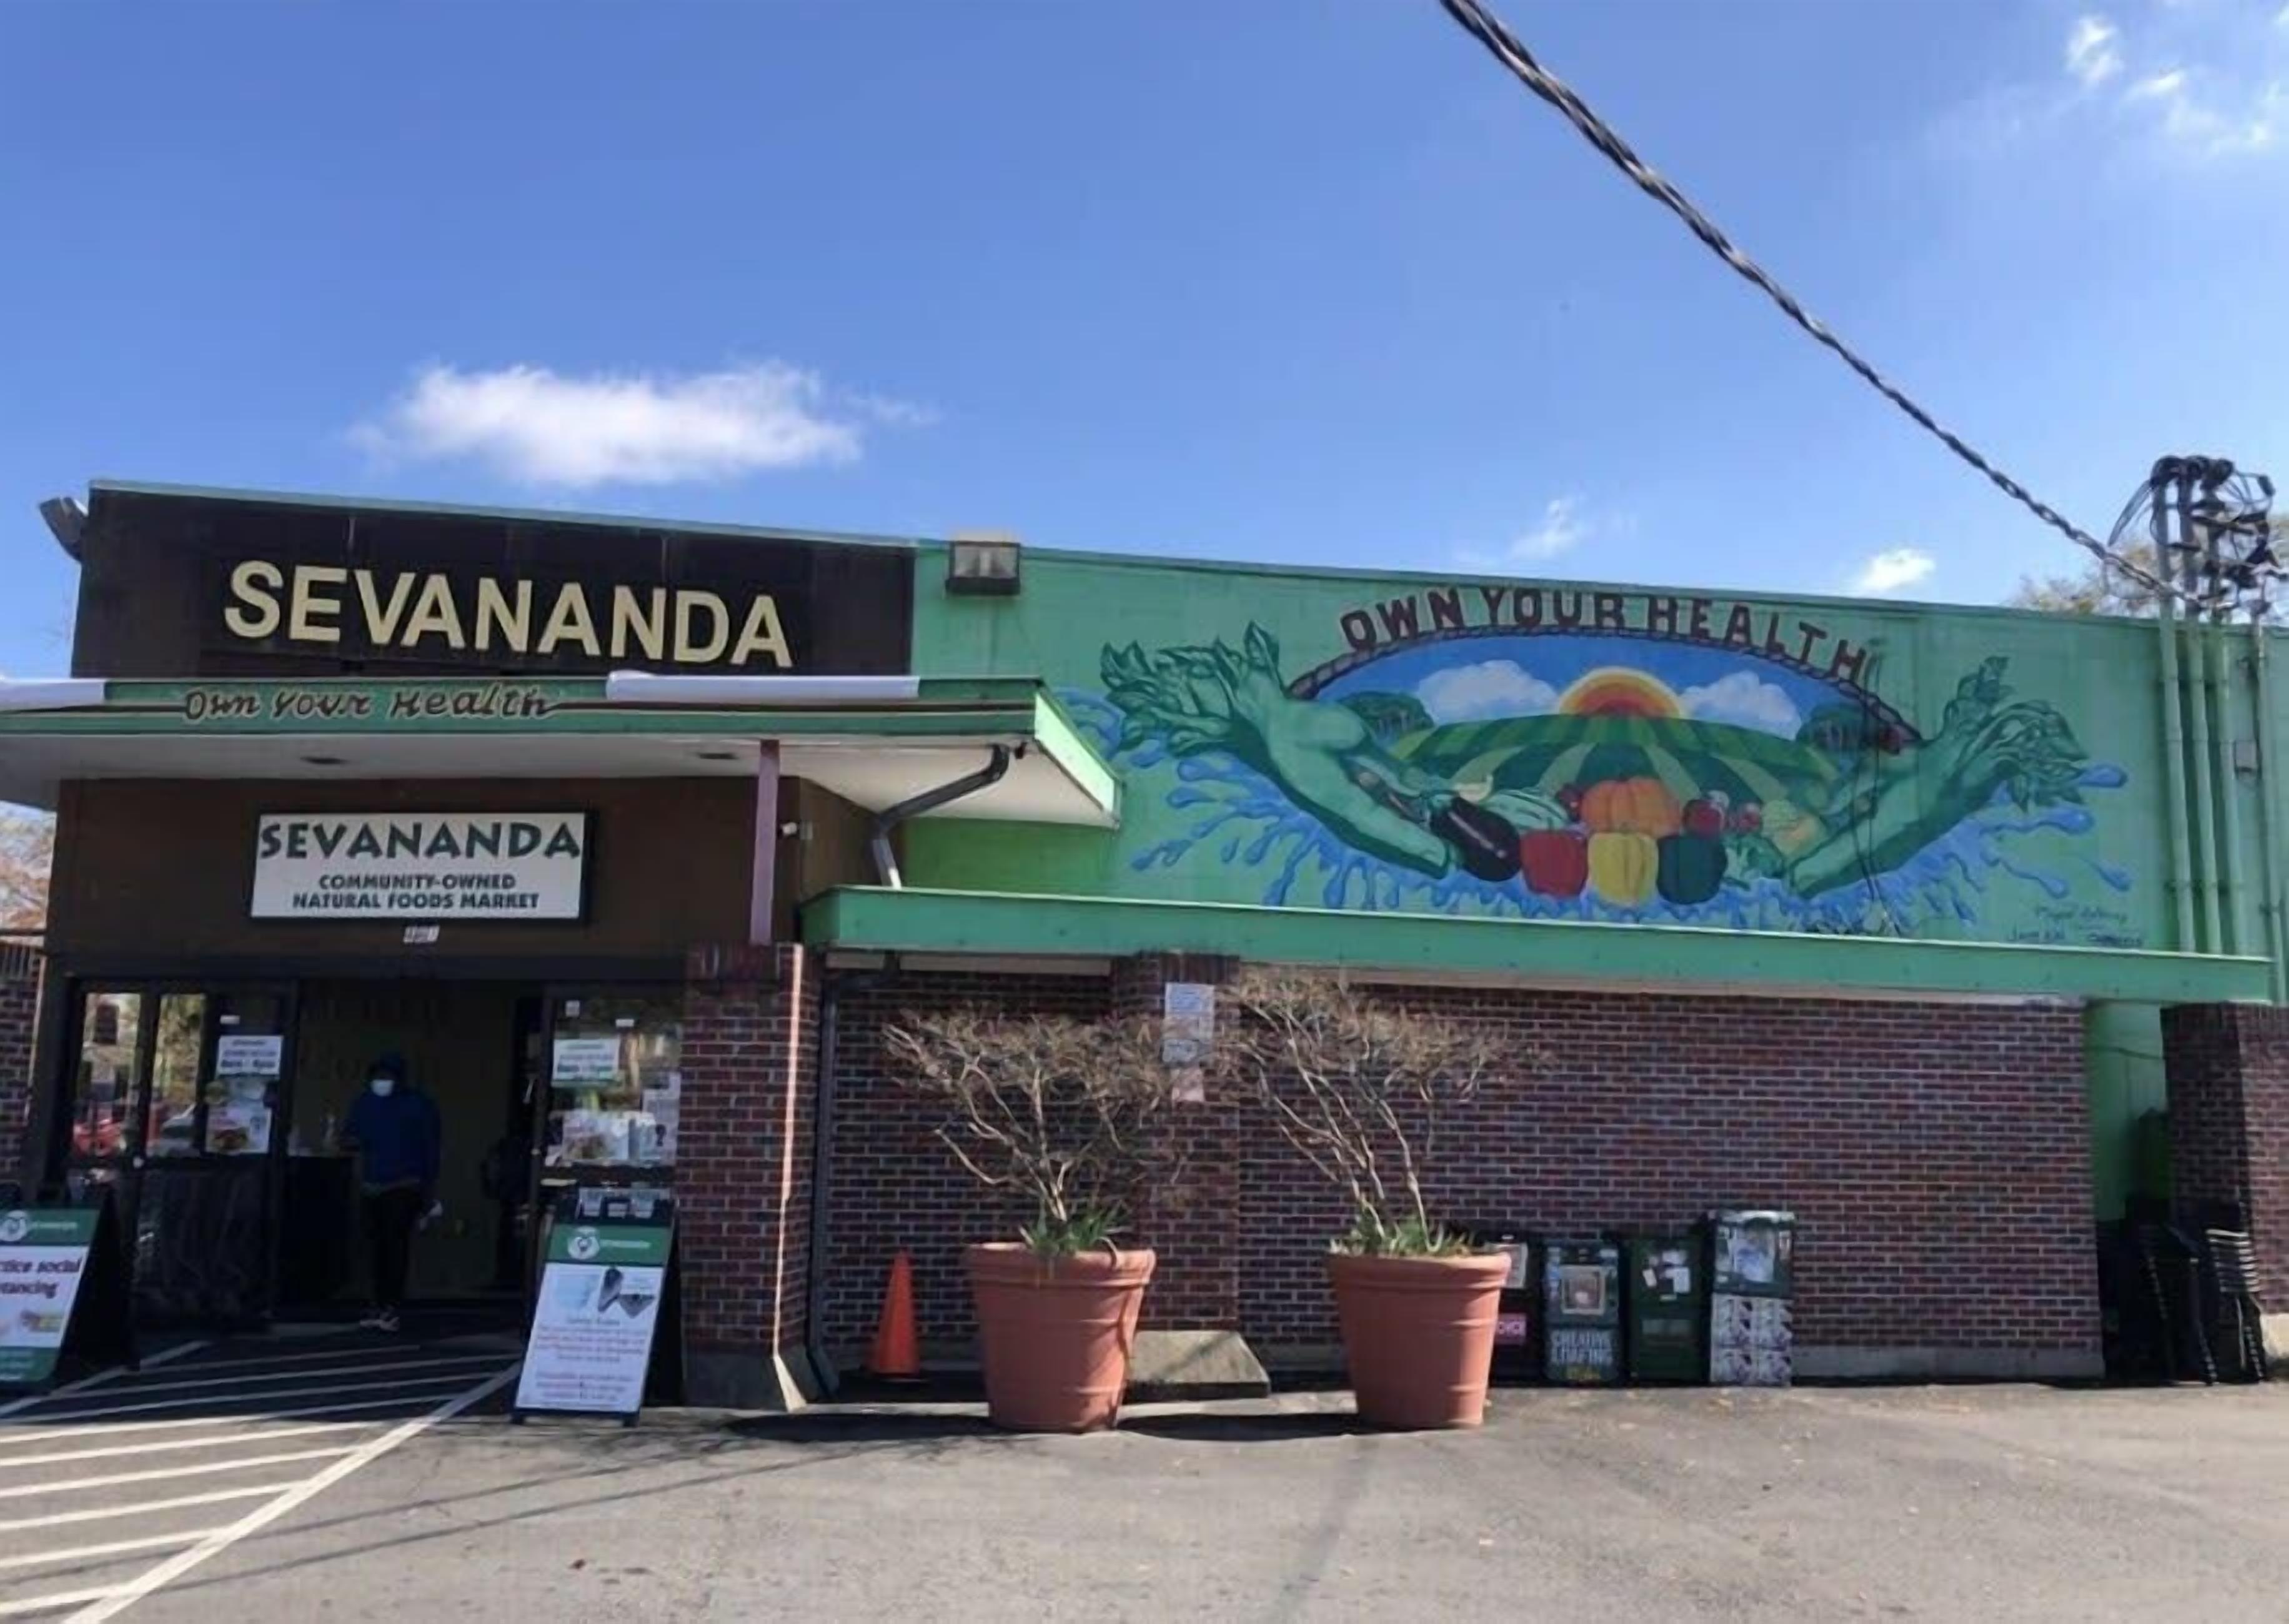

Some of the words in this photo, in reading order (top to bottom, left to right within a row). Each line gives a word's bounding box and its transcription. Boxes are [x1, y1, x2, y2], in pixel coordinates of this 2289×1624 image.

[224, 561, 793, 668] SEVANANDA
[1339, 587, 1463, 653] OWN
[1481, 585, 1624, 626] YOUR
[1647, 595, 1867, 682] HEALTH
[187, 690, 259, 720] Own
[390, 684, 547, 717] Health
[259, 821, 581, 859] SEVANANDA
[319, 874, 516, 890] COMMUNITY-OWNED
[292, 893, 381, 909] NATURAL
[387, 893, 453, 909] FOODS
[459, 893, 540, 909] MARKET
